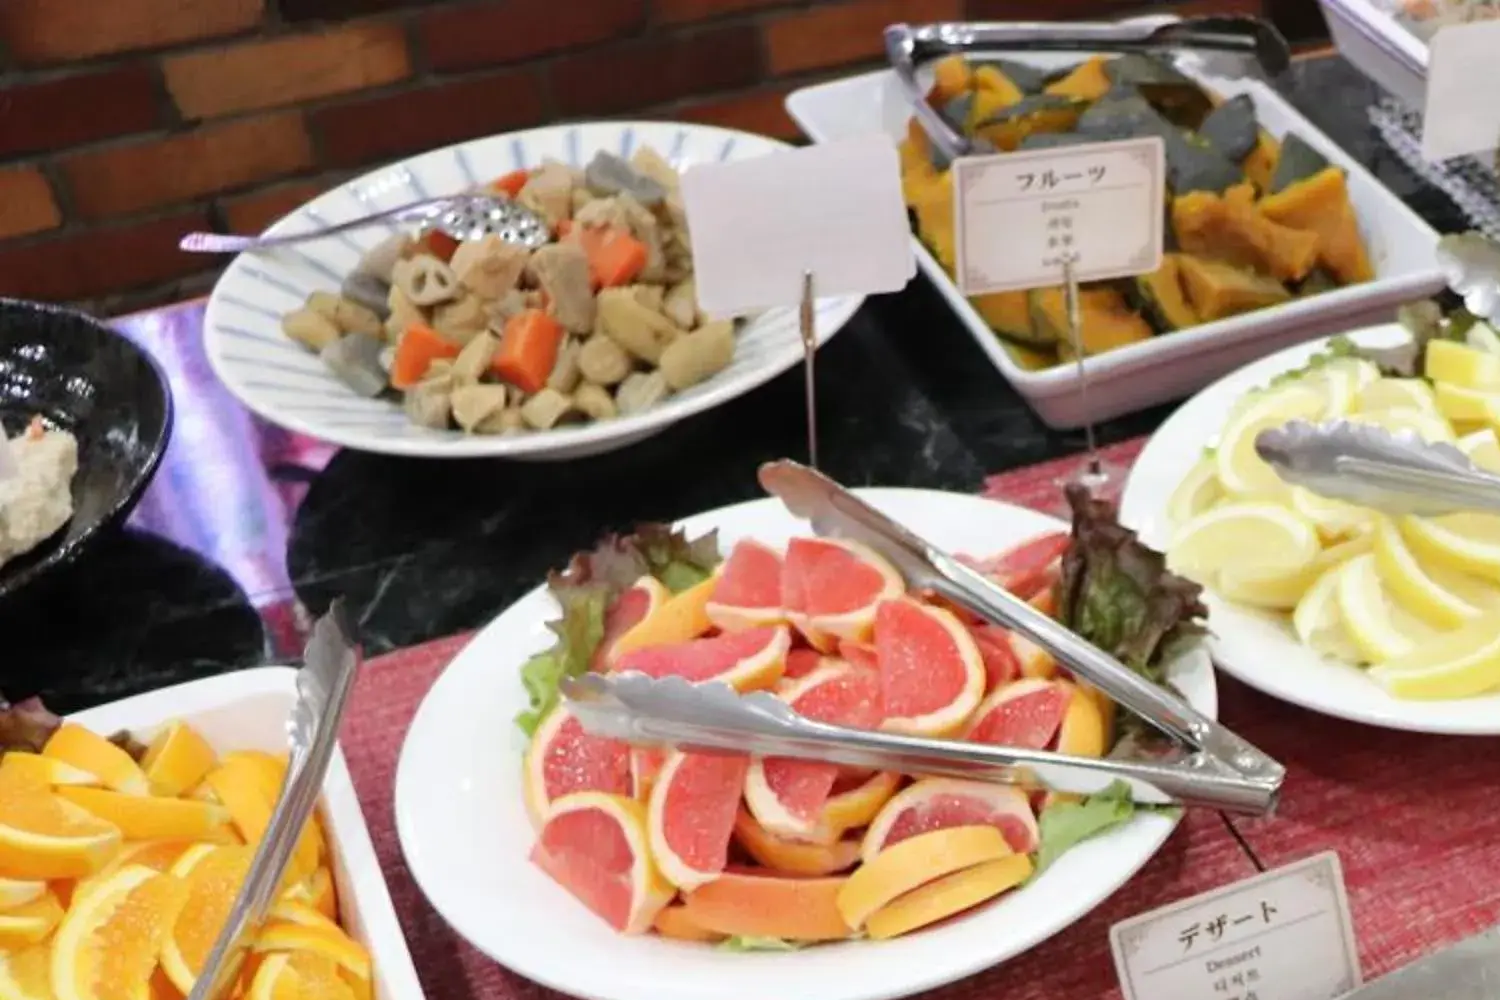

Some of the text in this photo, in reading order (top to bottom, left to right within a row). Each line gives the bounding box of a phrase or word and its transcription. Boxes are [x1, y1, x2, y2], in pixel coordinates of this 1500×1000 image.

[1016, 165, 1107, 191] フルーツ
[1178, 900, 1278, 953] デザート
[1205, 945, 1262, 973] Dessert
